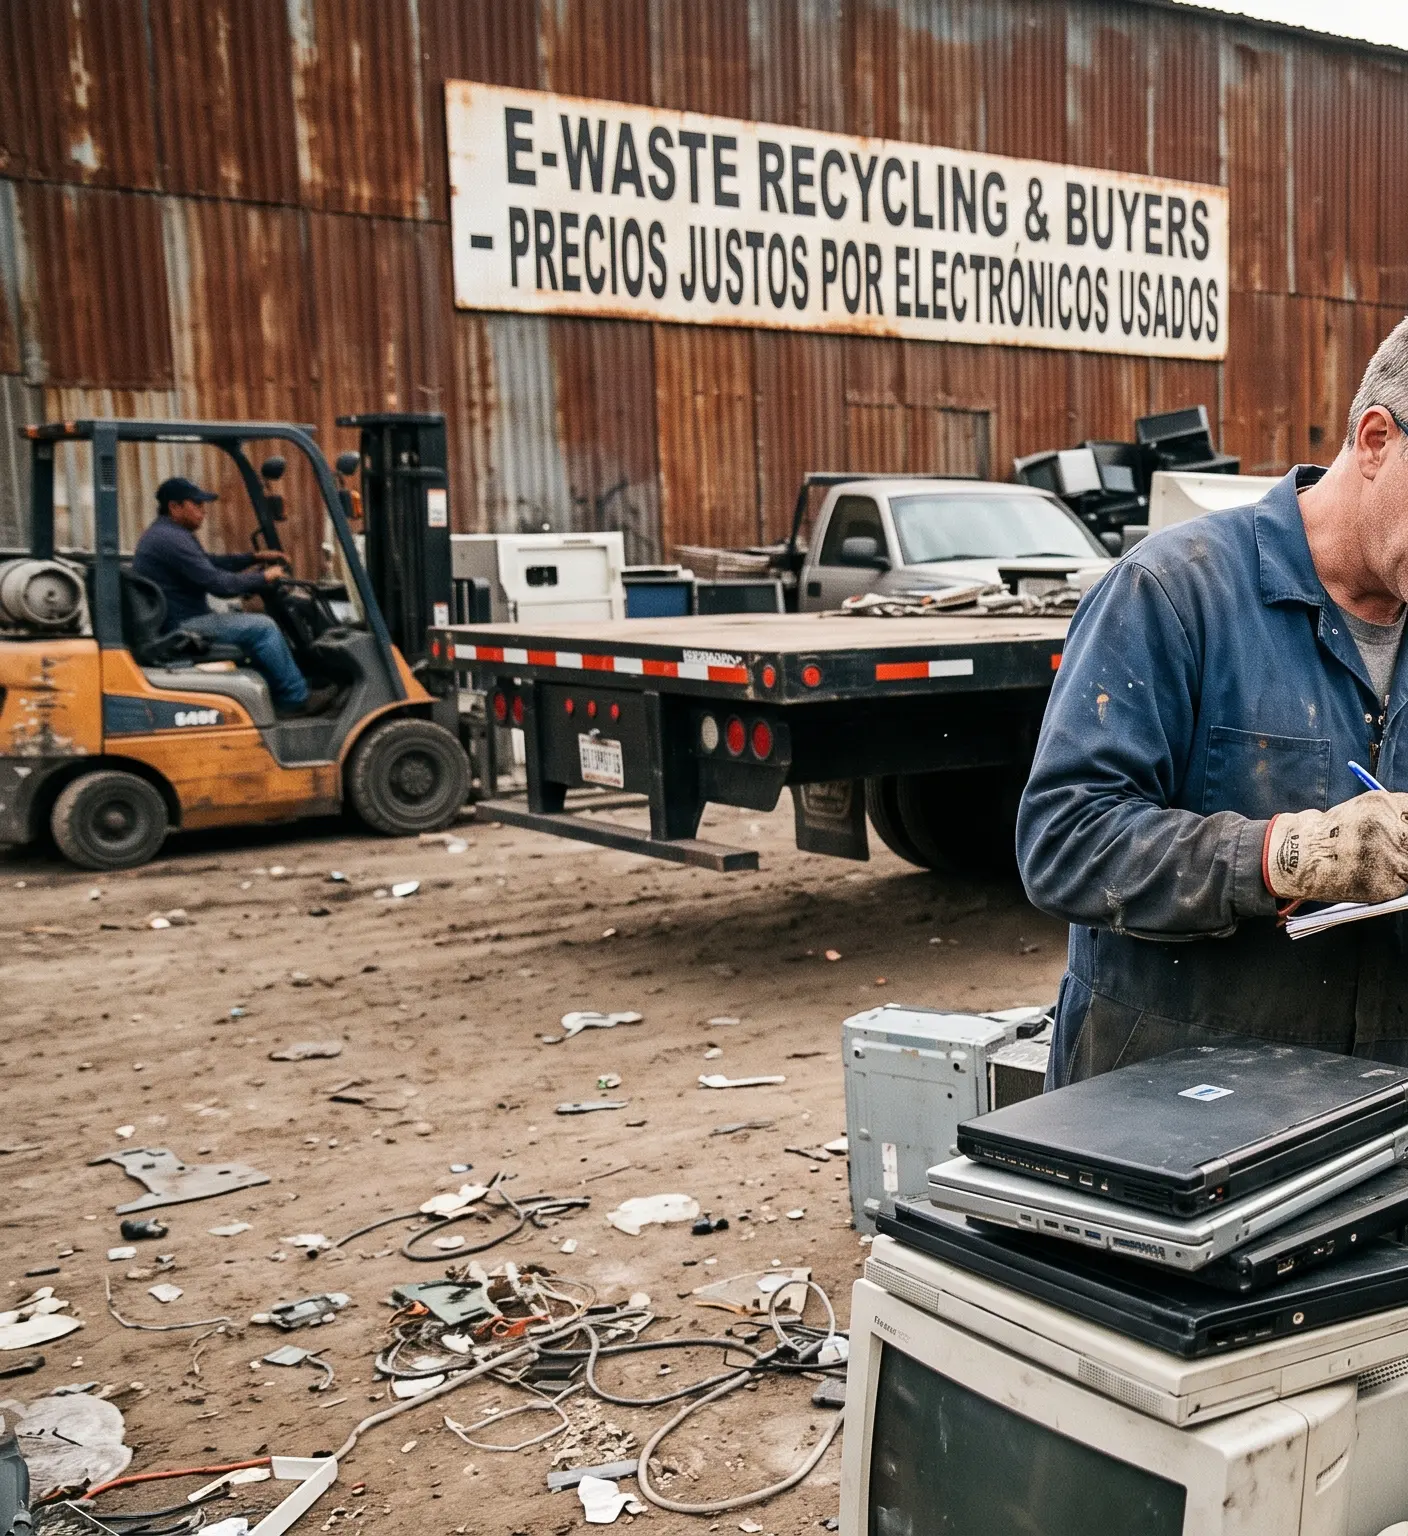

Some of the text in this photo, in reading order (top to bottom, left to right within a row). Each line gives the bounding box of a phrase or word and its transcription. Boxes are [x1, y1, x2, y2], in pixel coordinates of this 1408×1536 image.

[504, 106, 1210, 261] E-WASTE RECYCLING & BUYERS
[508, 207, 668, 300] PRECIOS
[680, 226, 809, 311] JUSTOS
[821, 238, 884, 316] POR
[895, 241, 1110, 334] ELECTRÓNICOS
[1119, 271, 1219, 343] USADOS
